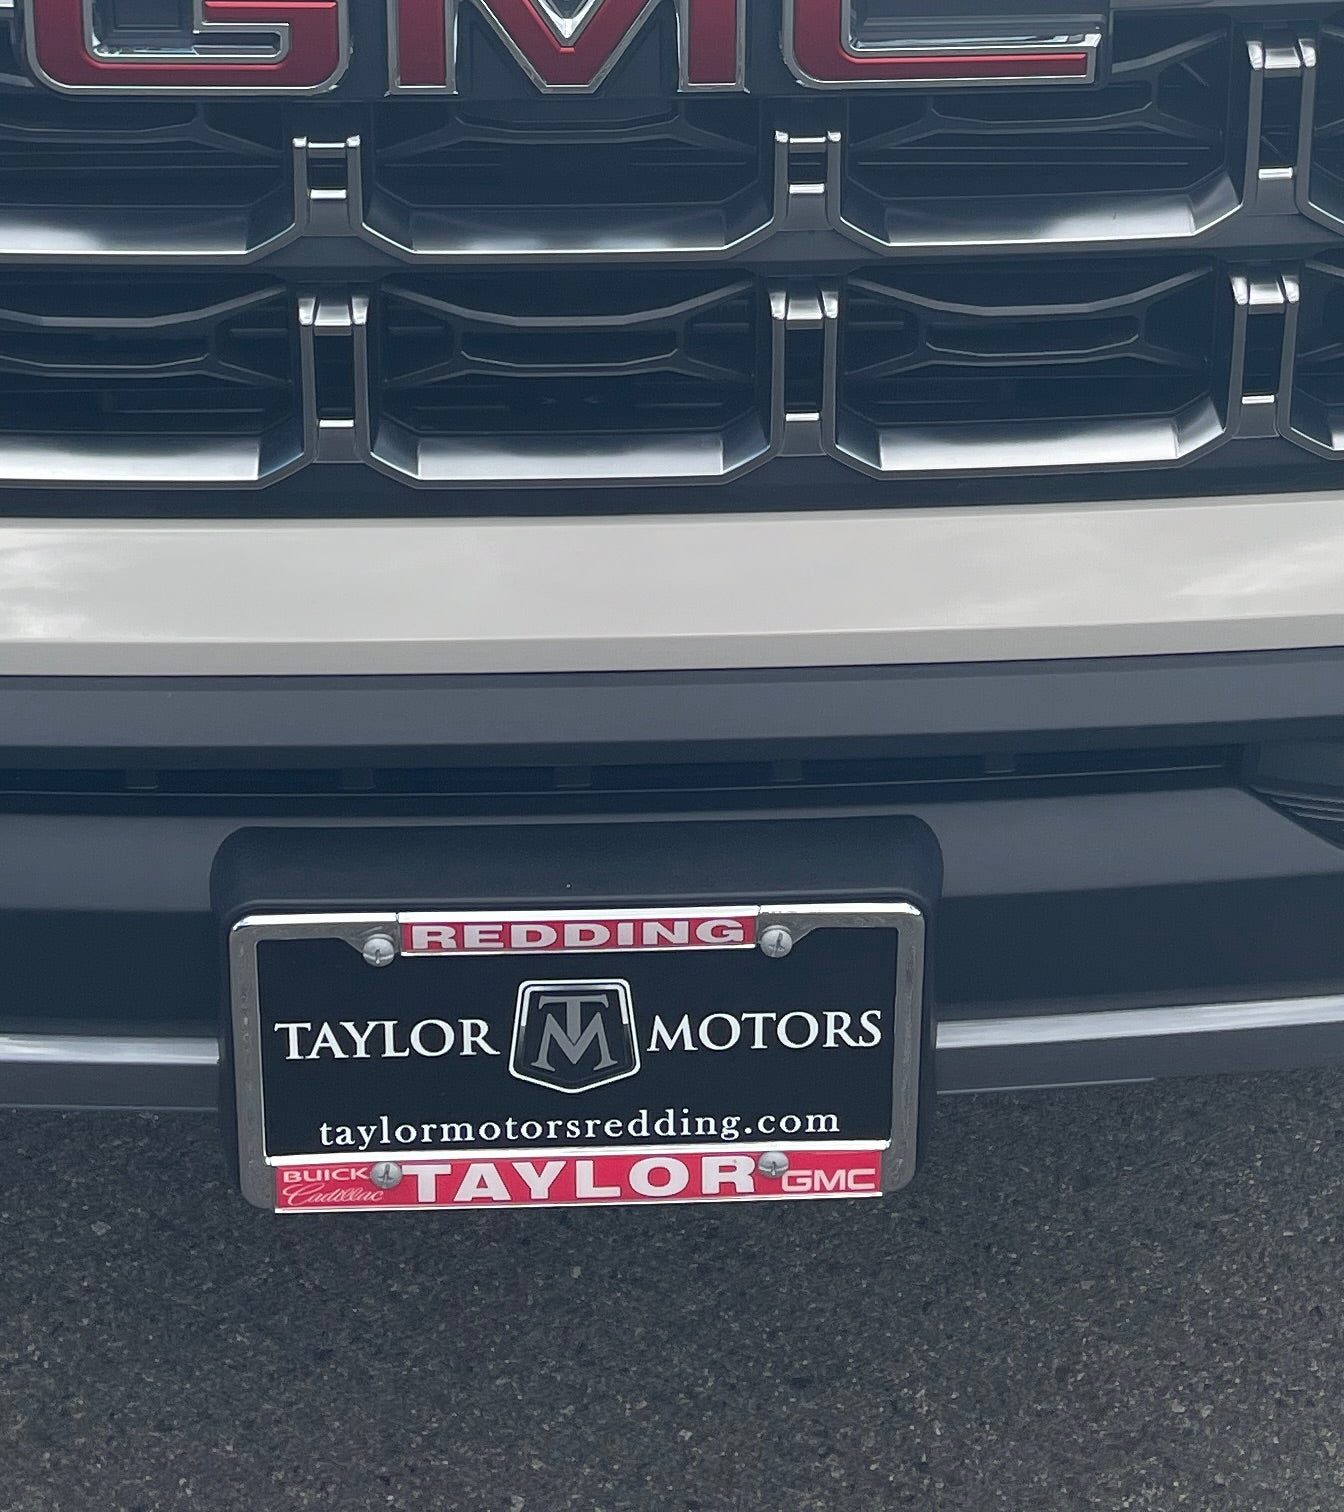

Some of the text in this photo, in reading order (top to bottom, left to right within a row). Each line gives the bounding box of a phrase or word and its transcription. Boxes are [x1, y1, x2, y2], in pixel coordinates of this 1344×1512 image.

[412, 919, 744, 949] REDDING
[274, 1010, 883, 1060] TAYLOR MOTORS
[319, 1108, 840, 1150] taylormotorsredding.com
[282, 1167, 371, 1184] BUICK
[401, 1155, 755, 1203] TAYLOR
[780, 1167, 876, 1193] GMC
[282, 1182, 384, 1207] Cadillac
